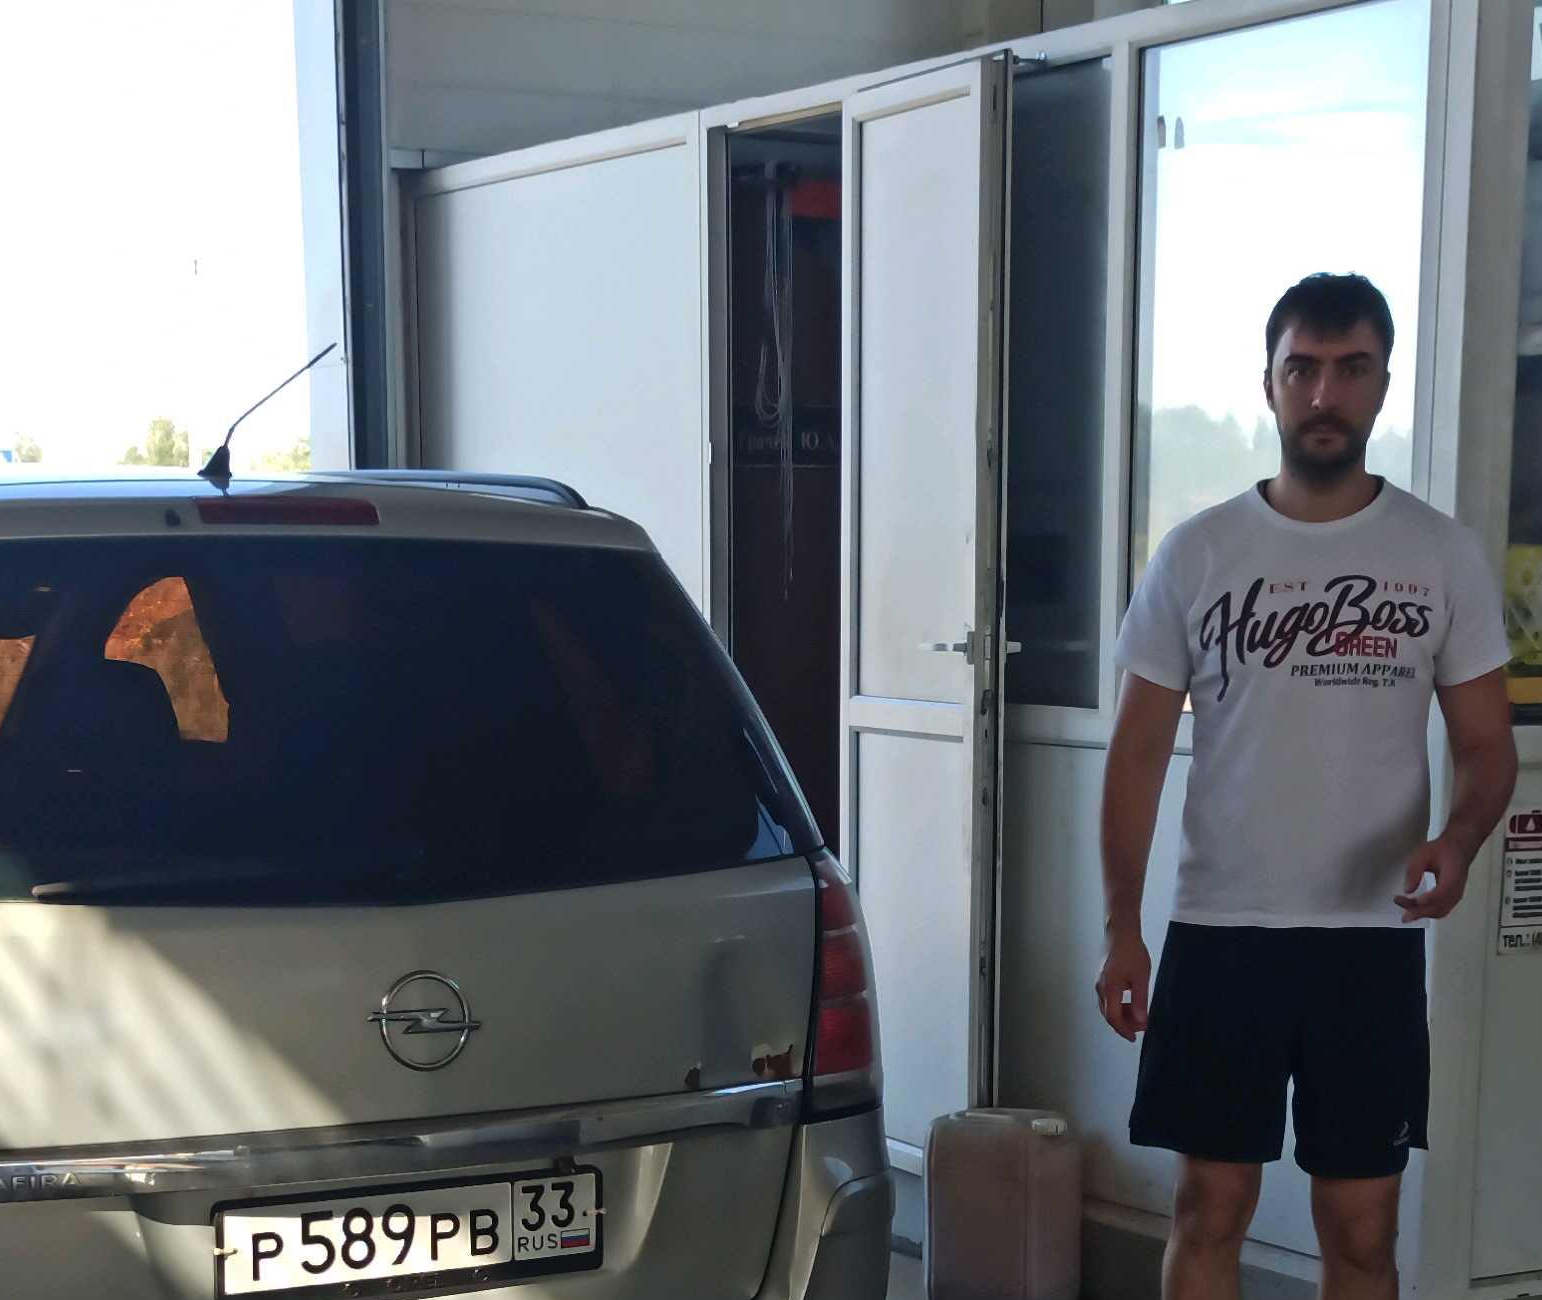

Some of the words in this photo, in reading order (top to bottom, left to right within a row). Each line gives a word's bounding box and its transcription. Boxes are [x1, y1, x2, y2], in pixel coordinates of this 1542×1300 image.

[1269, 580, 1308, 594] EST
[1199, 577, 1329, 702] Hugo
[1306, 574, 1433, 657] Boss
[1290, 663, 1359, 677] PREMIUM
[521, 1181, 575, 1231] 33
[517, 1233, 559, 1253] RUS
